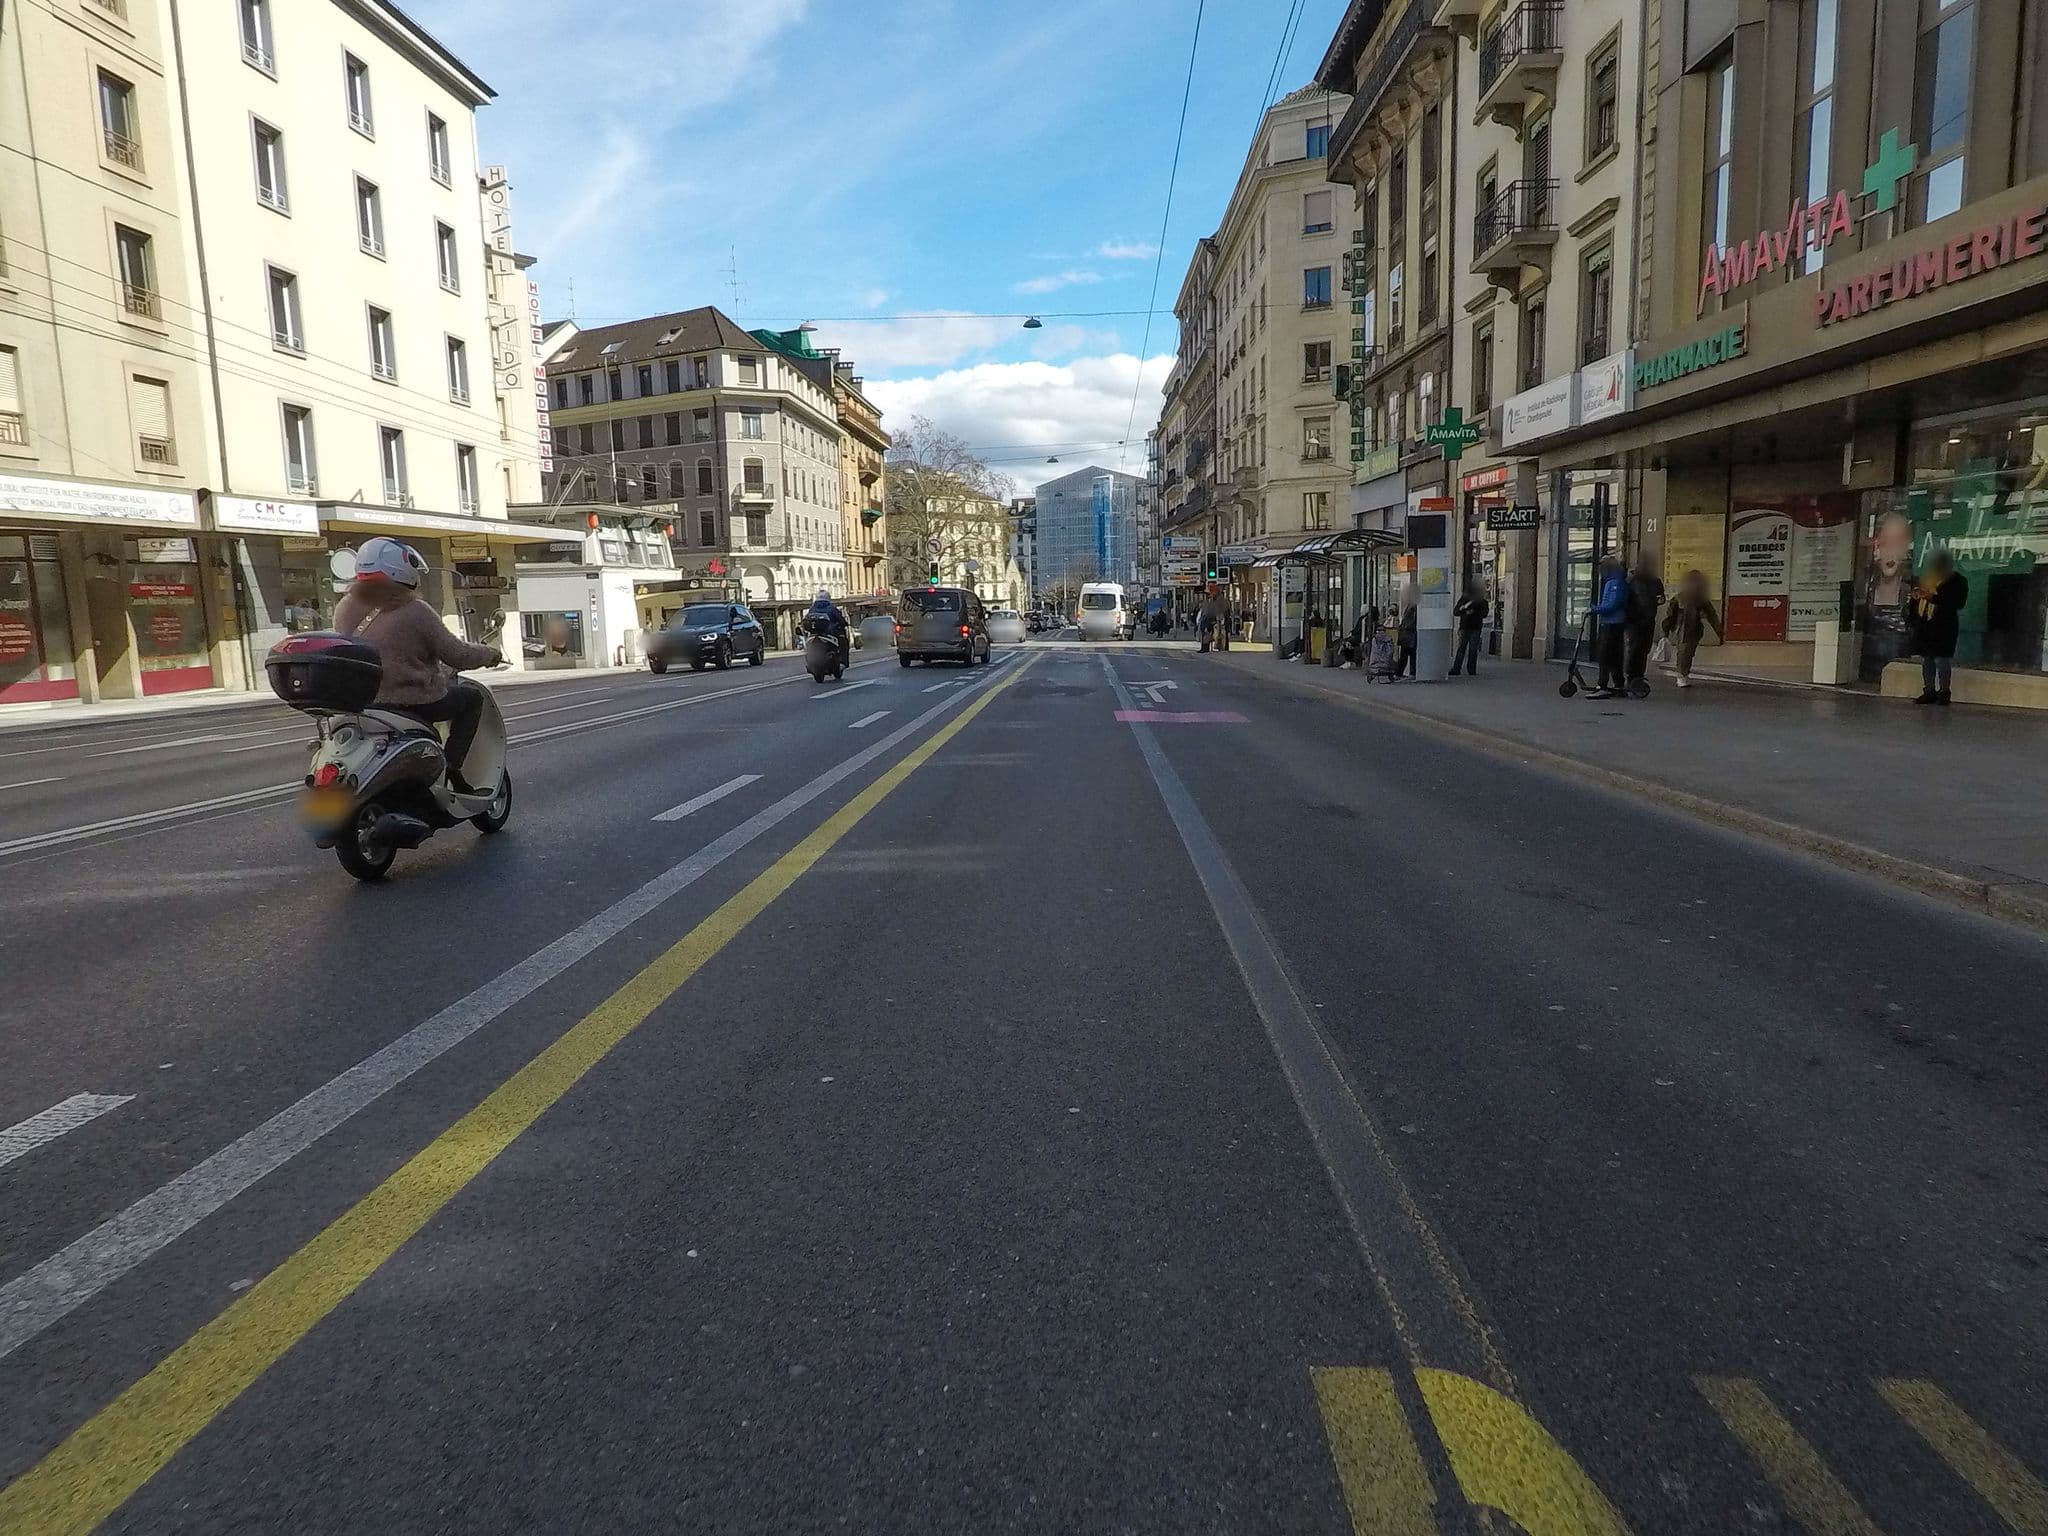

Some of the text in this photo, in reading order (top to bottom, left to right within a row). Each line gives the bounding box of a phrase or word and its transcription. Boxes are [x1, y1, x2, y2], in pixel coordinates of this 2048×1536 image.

[490, 167, 519, 387] HOTEL LIDO
[1698, 189, 1854, 315] AMAVITA
[1813, 206, 2047, 325] PARFUMERIE
[528, 282, 551, 471] HOTEL MODERNE
[1634, 324, 1744, 391] PHARMACIE
[1429, 426, 1478, 441] AMAVITA
[1647, 518, 1657, 532] 21
